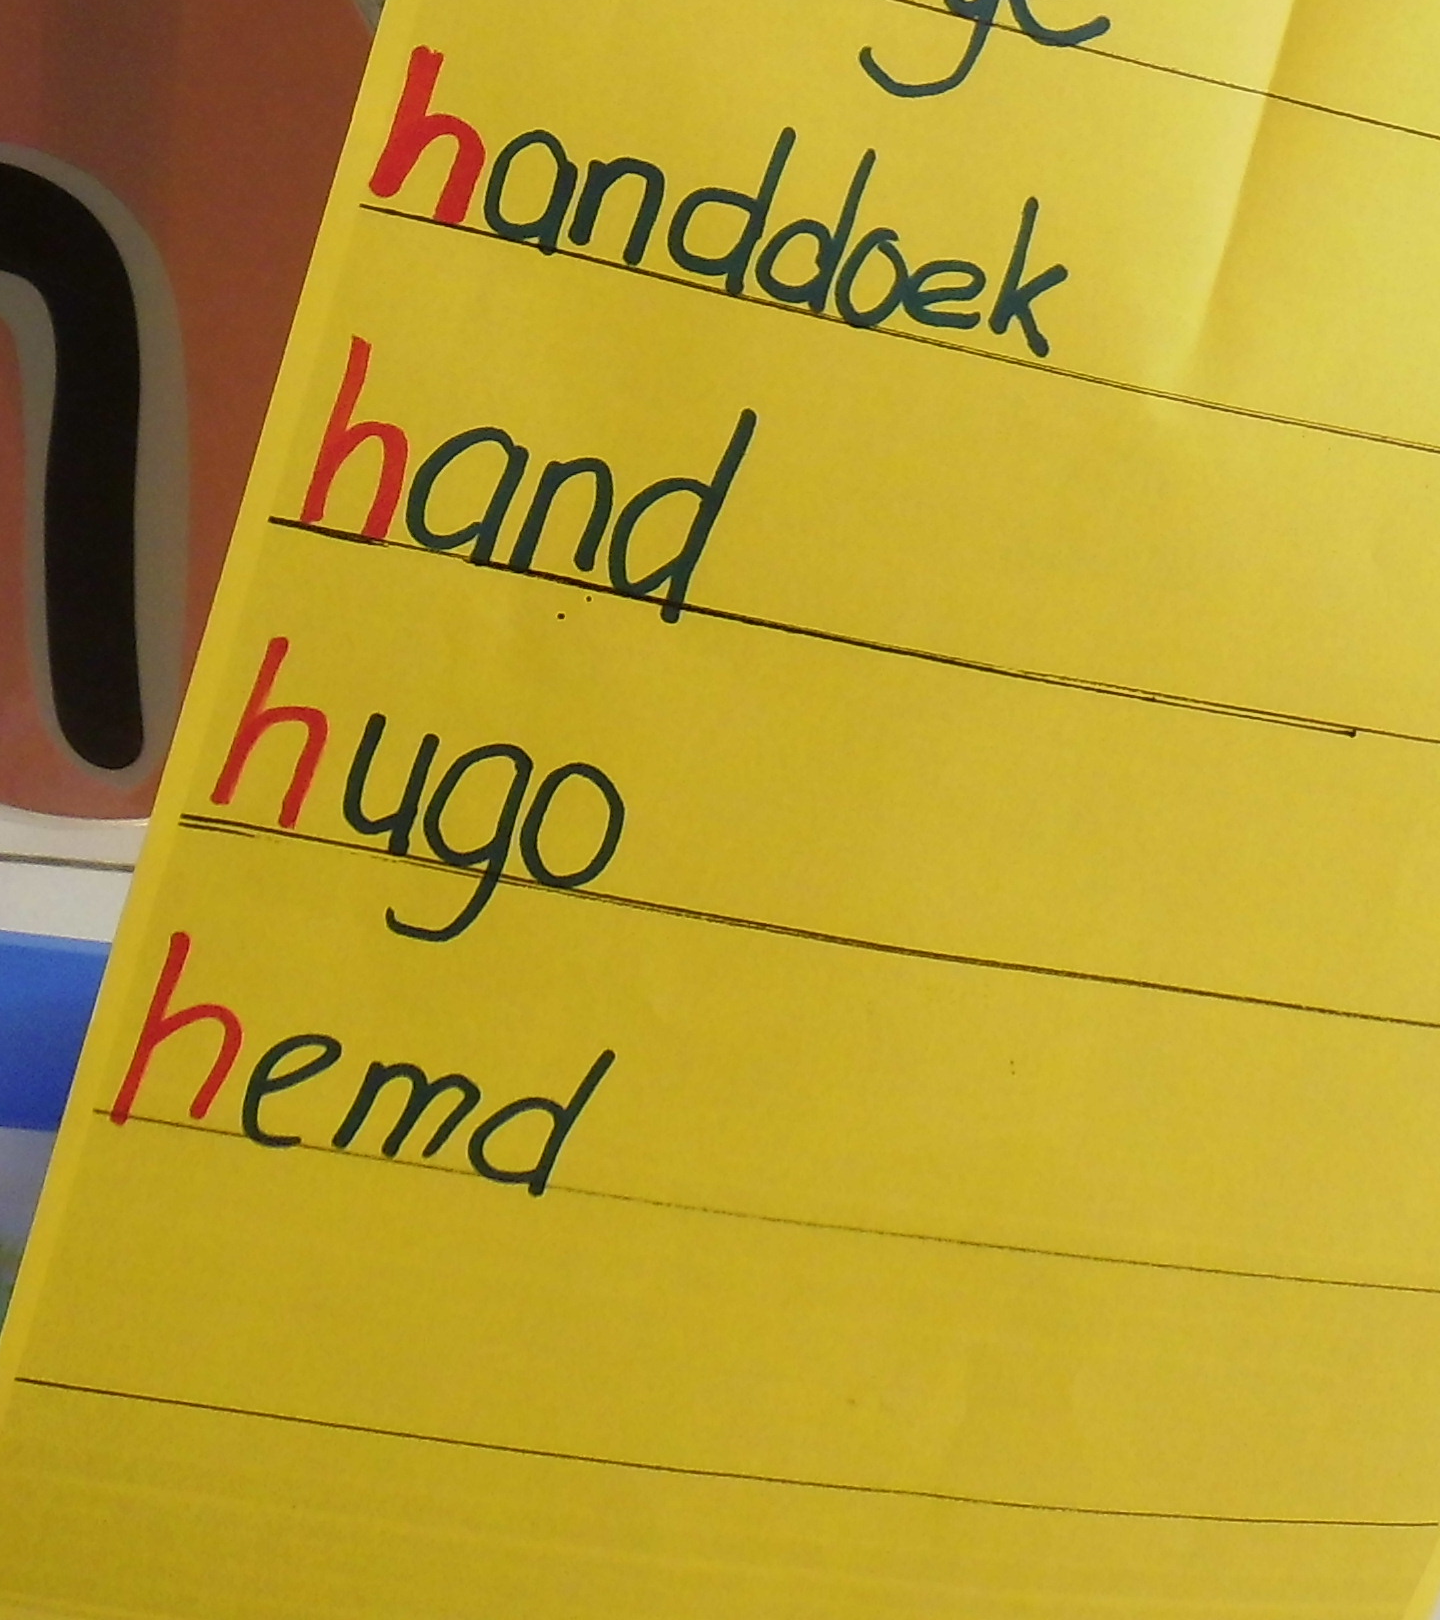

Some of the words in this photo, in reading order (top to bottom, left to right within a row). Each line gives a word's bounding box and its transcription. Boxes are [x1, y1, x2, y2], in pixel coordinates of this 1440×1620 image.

[367, 45, 1069, 357] handdoek
[299, 334, 757, 624] hand
[210, 636, 626, 943] hugo
[111, 930, 616, 1198] hemd
